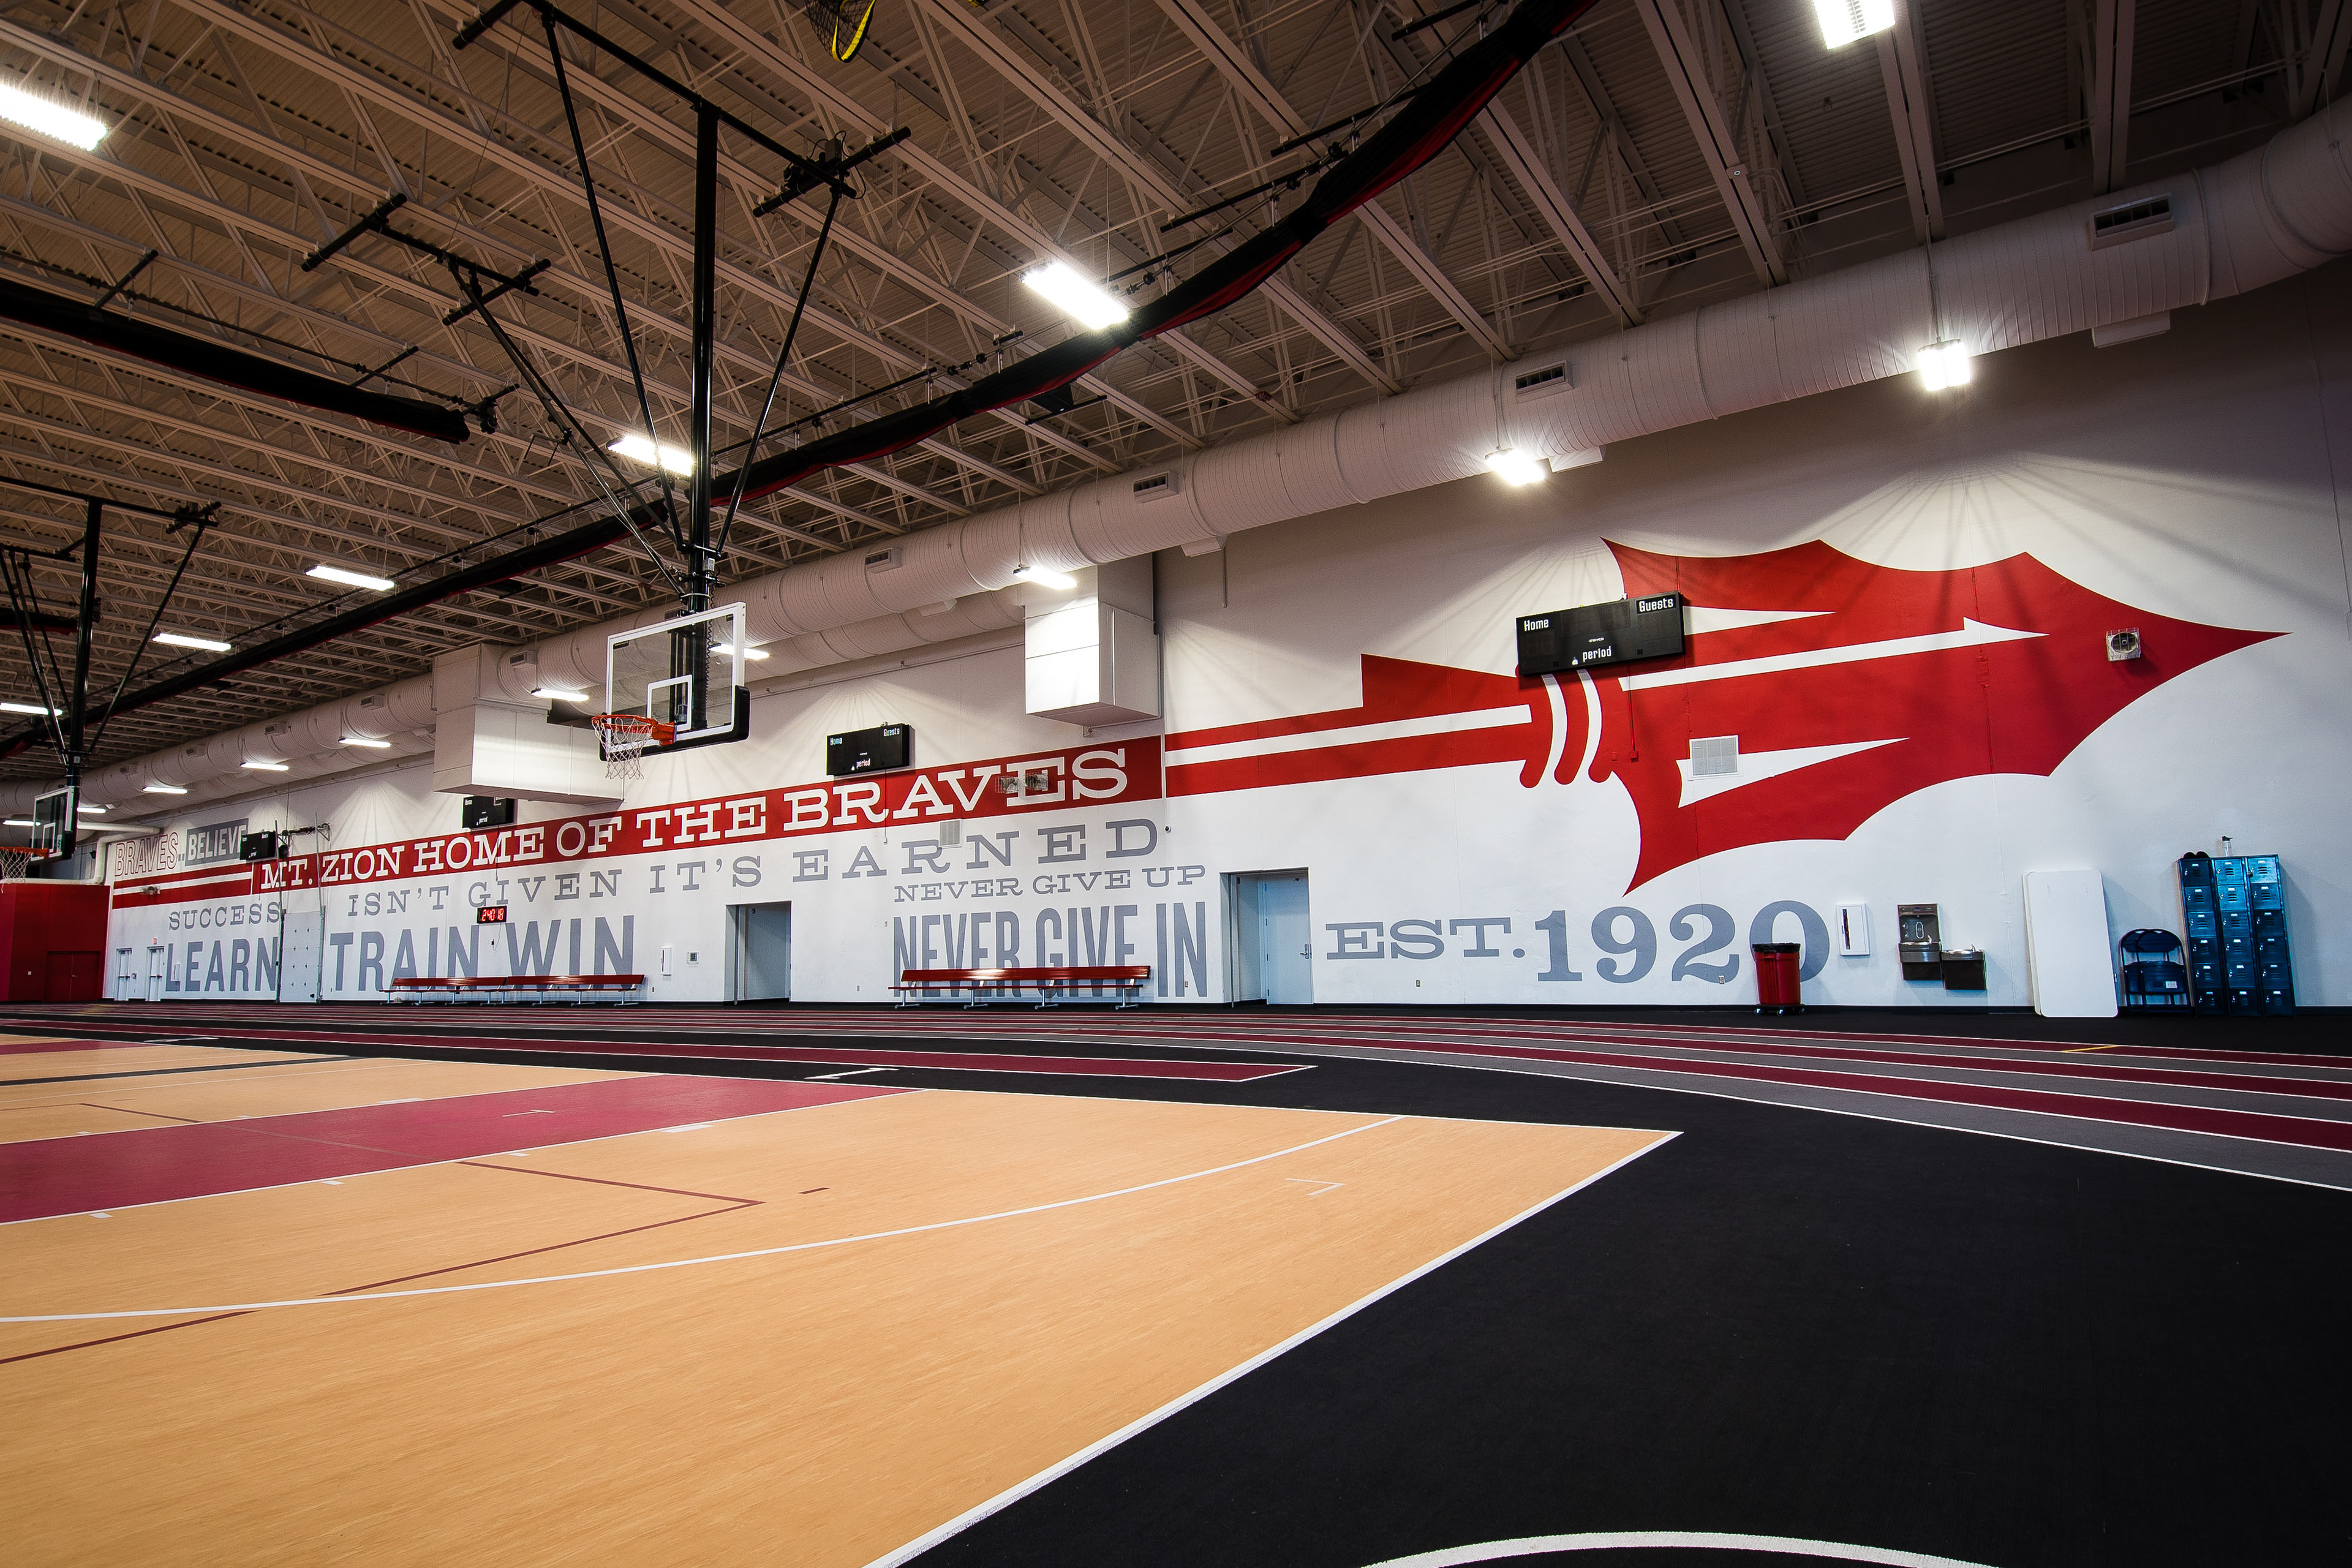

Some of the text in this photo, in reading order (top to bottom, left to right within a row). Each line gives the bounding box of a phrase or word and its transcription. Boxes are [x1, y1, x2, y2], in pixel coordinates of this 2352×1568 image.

[1523, 618, 1549, 631] Home
[1638, 597, 1673, 612] Guests
[1582, 645, 1612, 663] period
[260, 748, 1128, 890] MT. ZION HOME OF THE BRAVES
[168, 818, 1158, 931] SUCCESS ISN'T GIVEN IT'S EARNED
[894, 864, 1206, 903] NEVER GIVE UP
[165, 915, 635, 992] LEARN TRAIN WIN
[893, 901, 1208, 997] NEVER GIVE IN
[1325, 900, 1830, 984] EST. 1920
